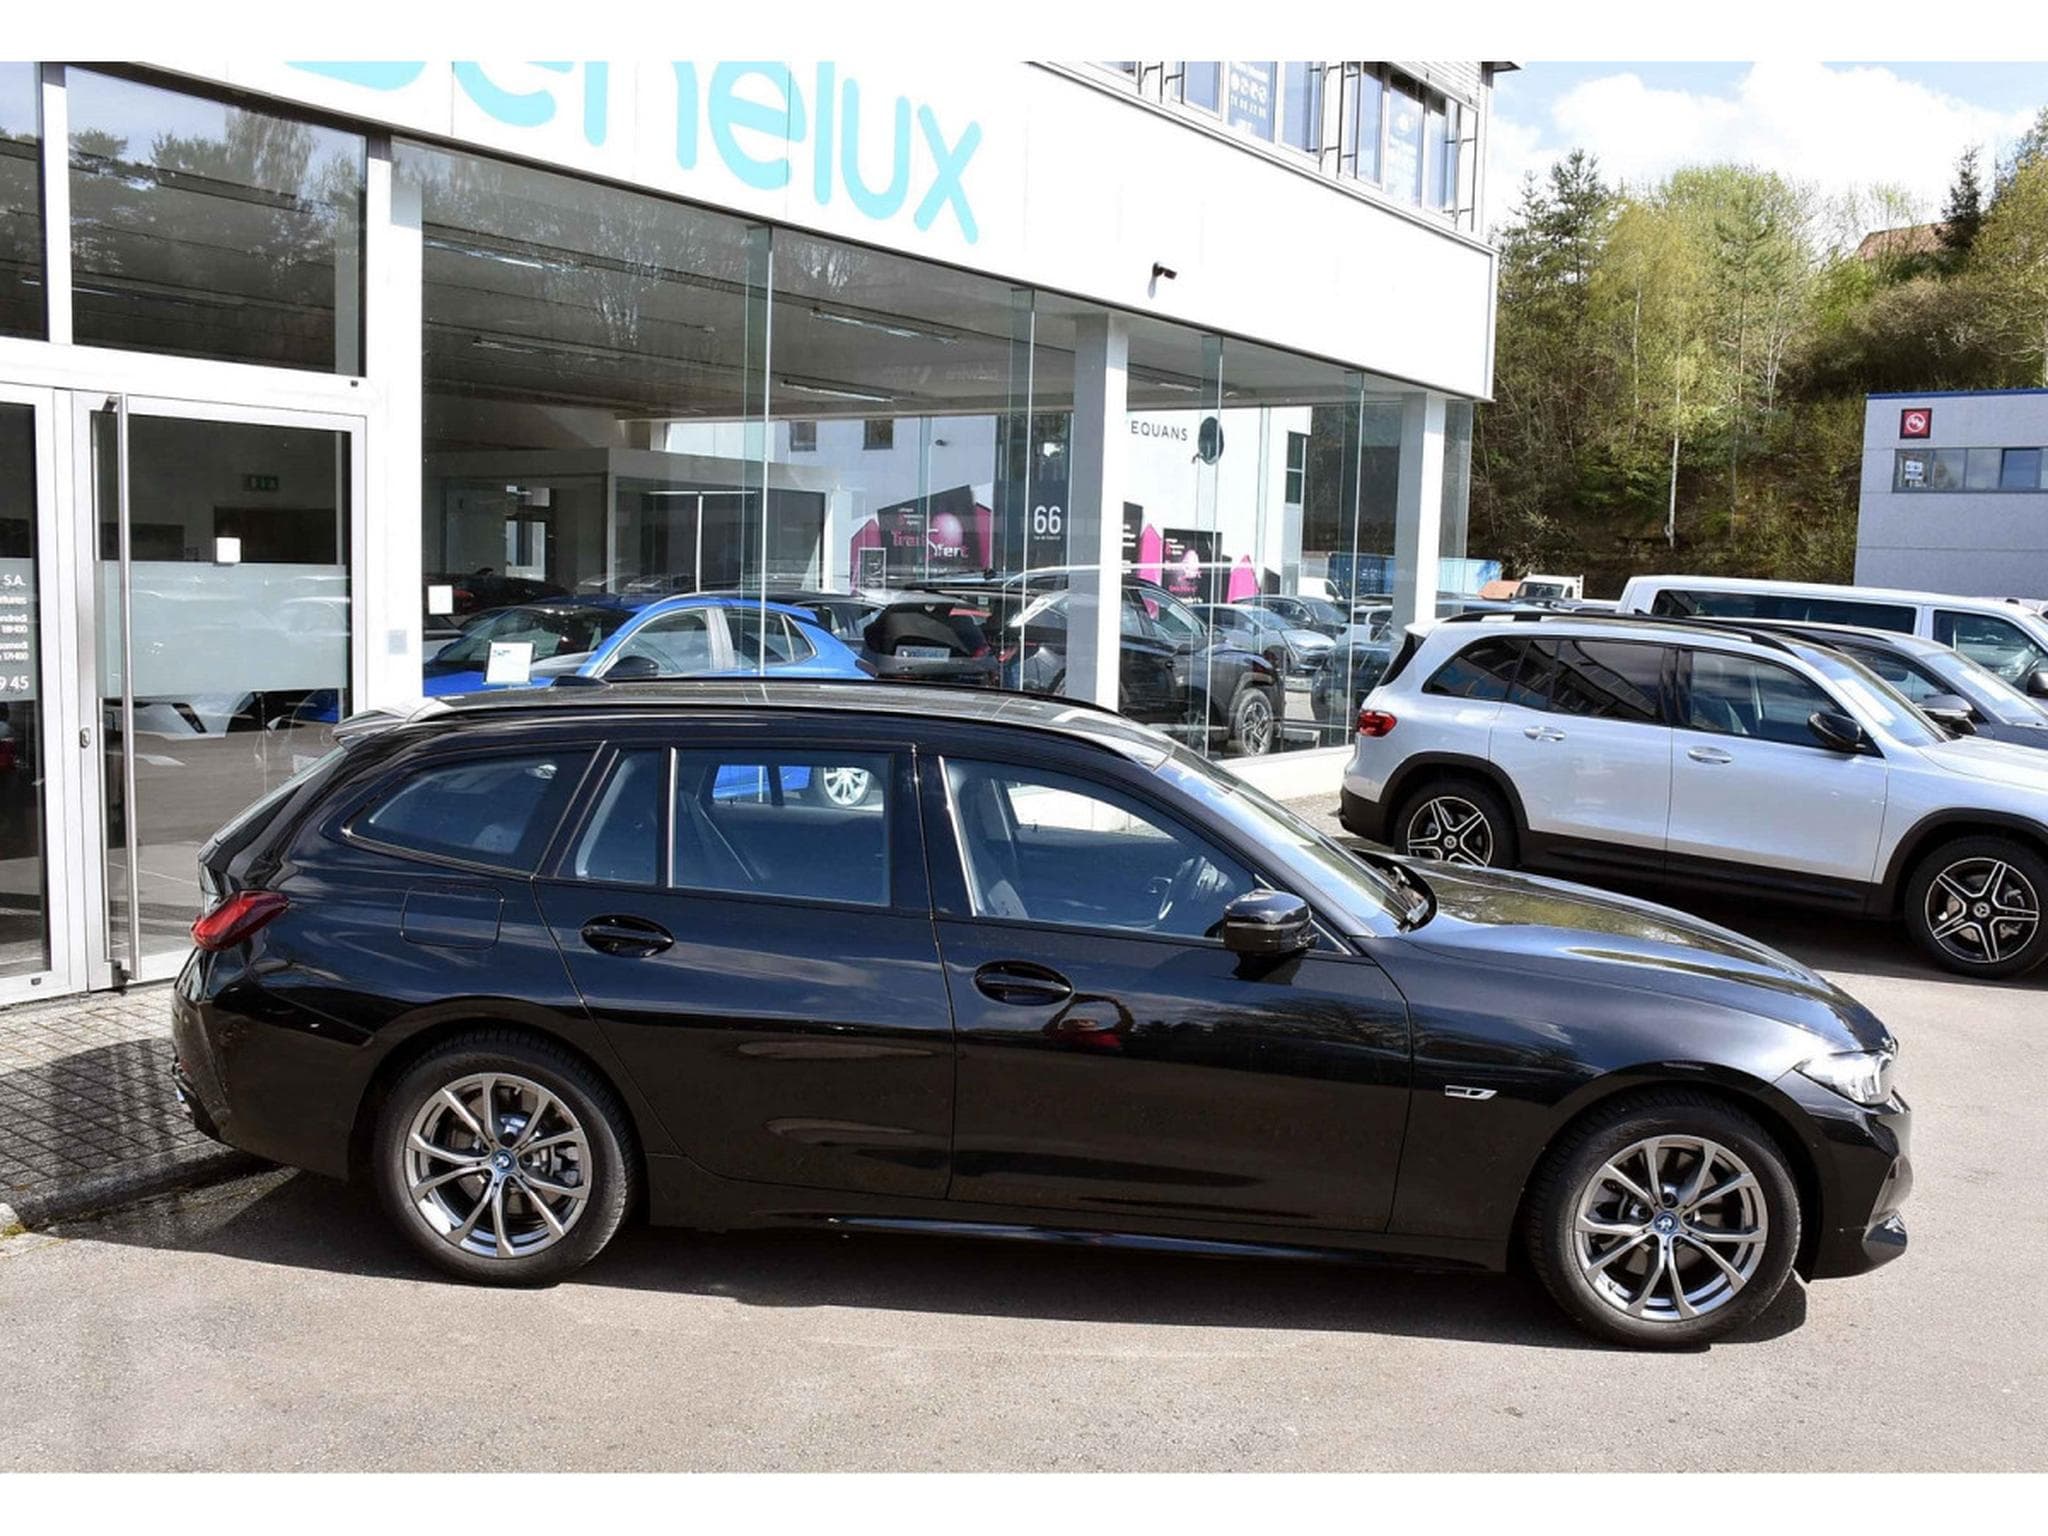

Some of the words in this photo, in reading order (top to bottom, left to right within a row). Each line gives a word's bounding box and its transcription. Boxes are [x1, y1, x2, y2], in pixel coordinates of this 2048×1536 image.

[1130, 420, 1188, 441] EQUANS
[1034, 505, 1061, 534] 66
[10, 676, 29, 690] 45
